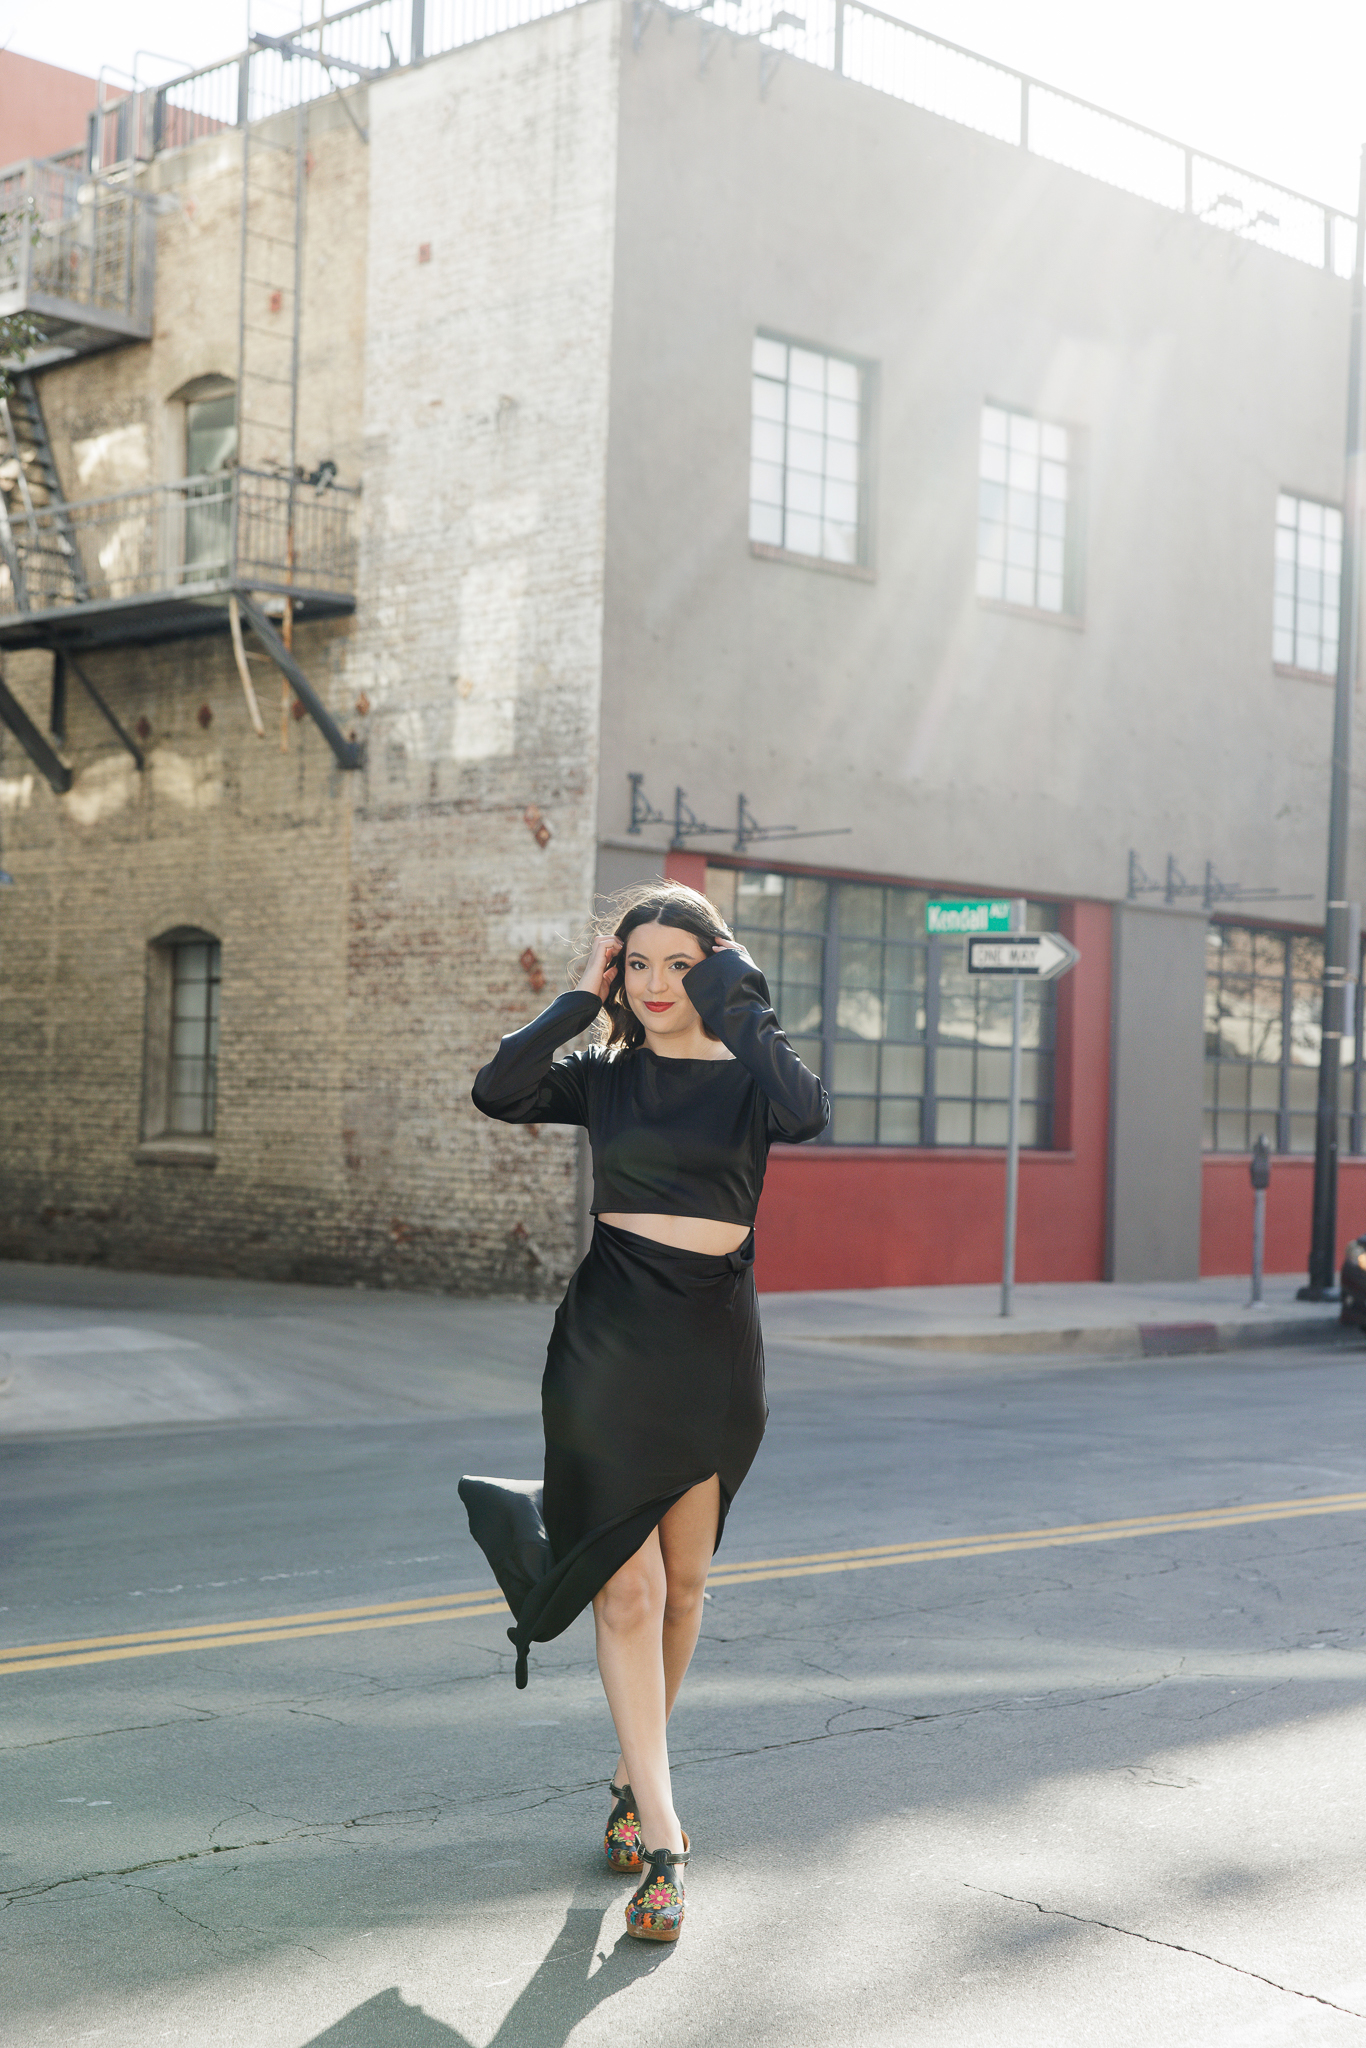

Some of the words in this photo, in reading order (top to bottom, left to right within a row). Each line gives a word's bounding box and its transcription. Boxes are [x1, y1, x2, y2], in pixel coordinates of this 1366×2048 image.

[928, 905, 988, 931] Kendall
[977, 947, 1003, 964] ONE
[1008, 947, 1037, 964] WAY
